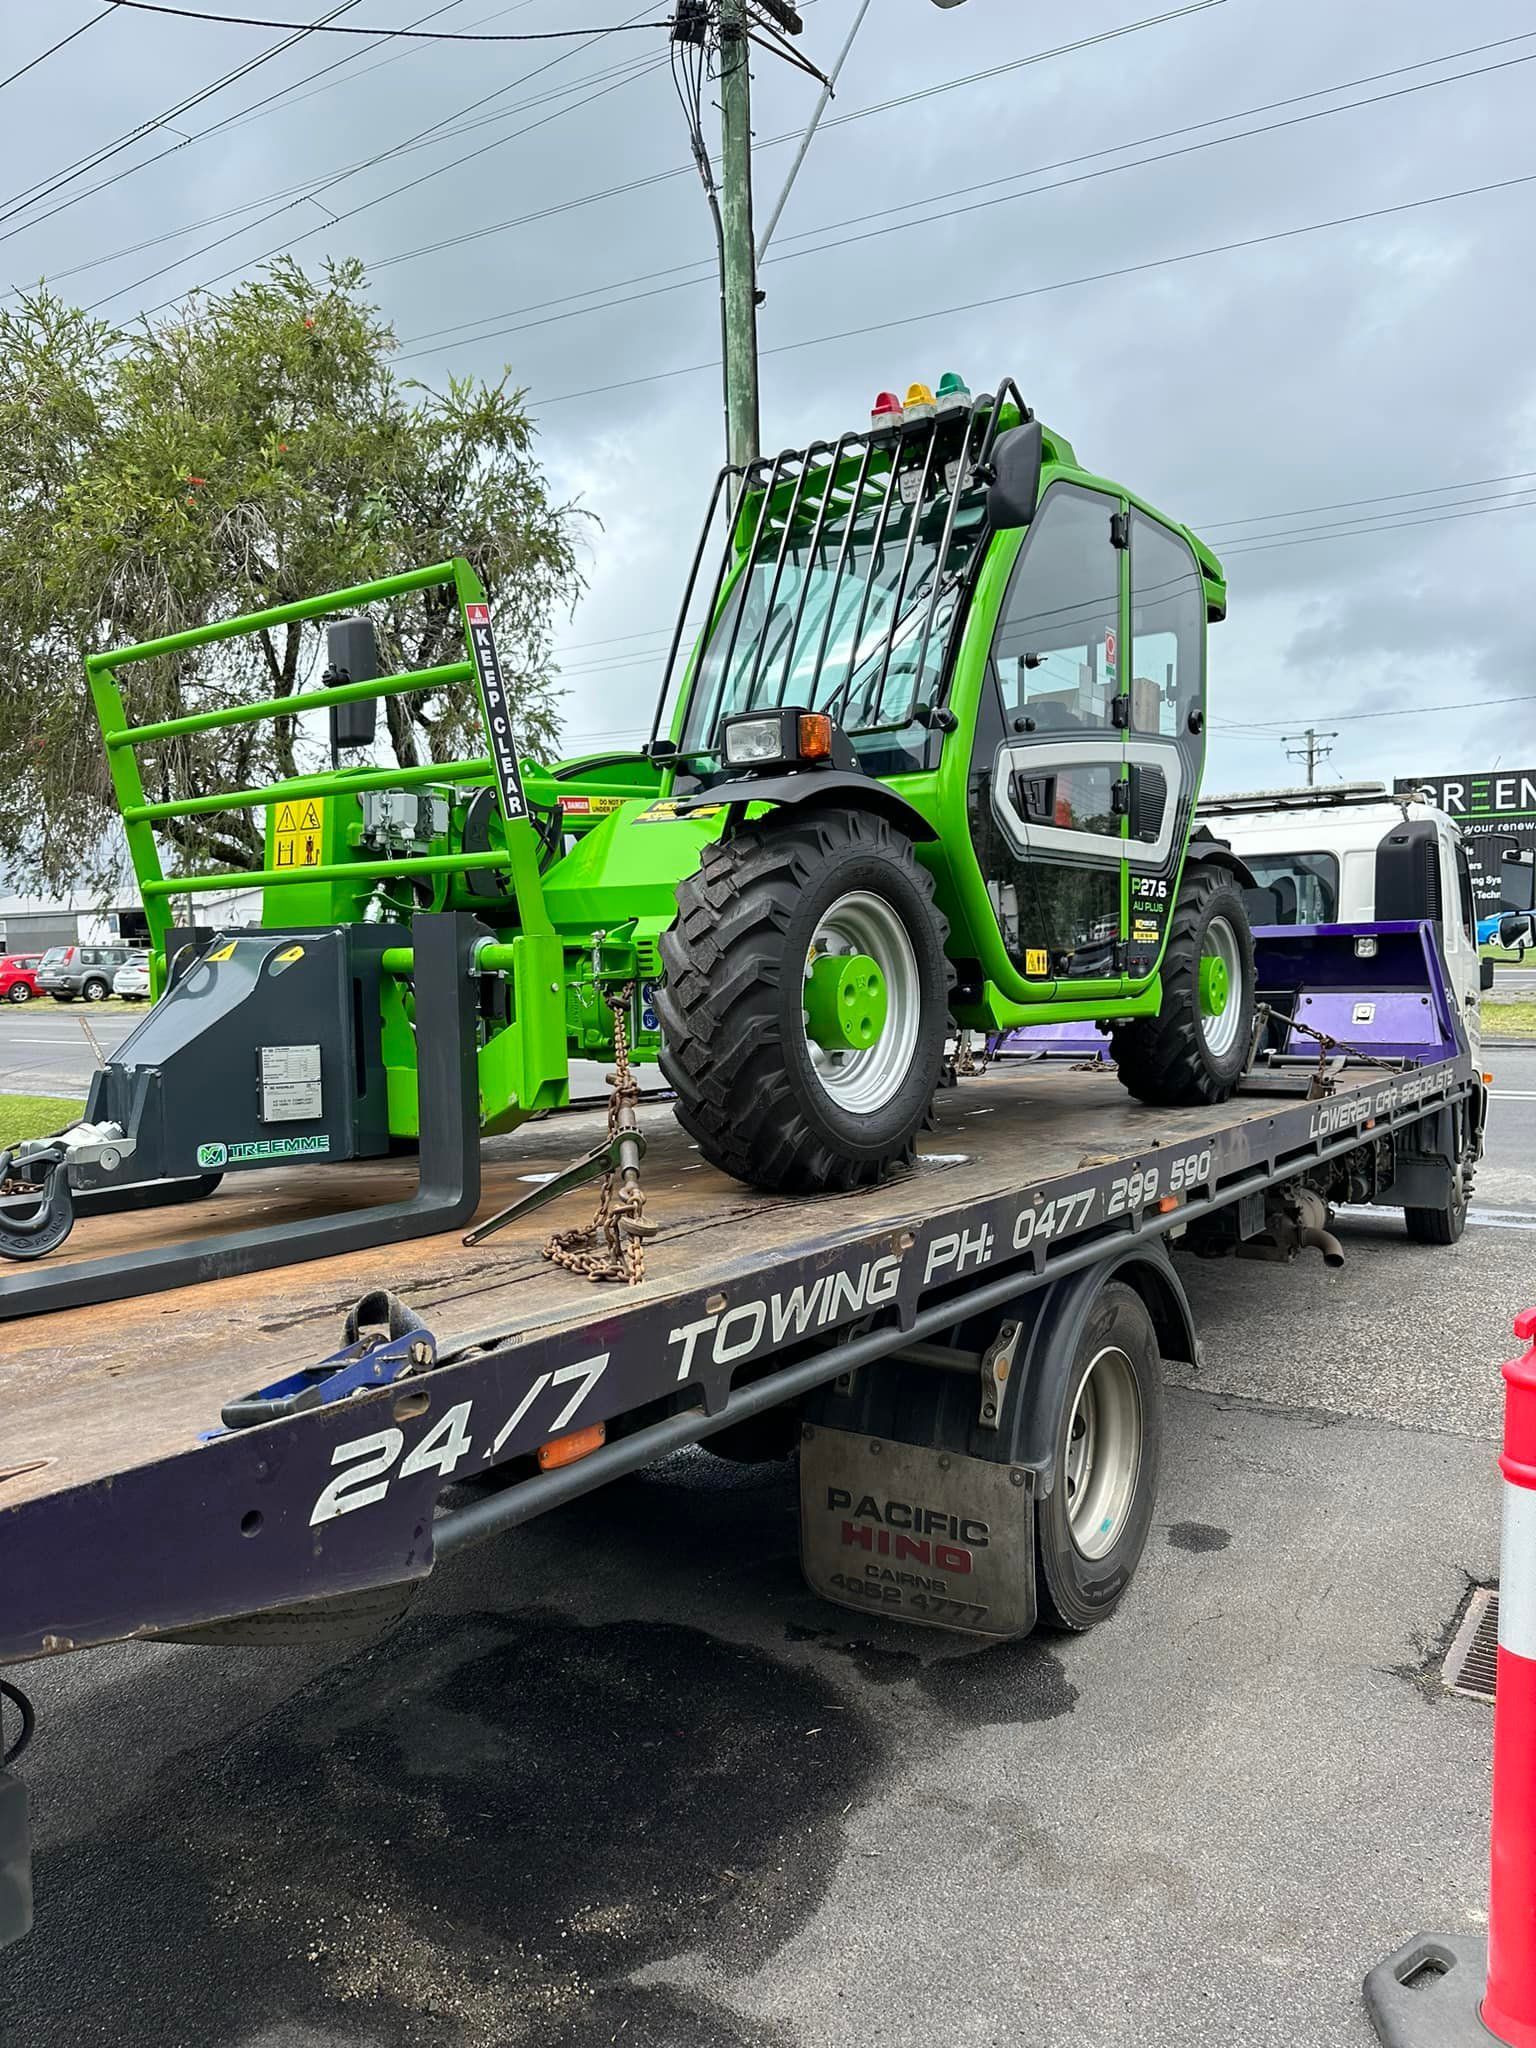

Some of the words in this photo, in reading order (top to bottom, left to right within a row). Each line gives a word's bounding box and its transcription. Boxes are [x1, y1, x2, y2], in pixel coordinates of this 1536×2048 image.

[475, 629, 500, 708] KEEP
[493, 717, 522, 814] CLEAR
[1498, 822, 1536, 832] renew
[1144, 901, 1164, 913] PLUS
[309, 1352, 610, 1527] 24/7
[668, 1254, 902, 1382] TOWING
[923, 1222, 994, 1285] PH:
[1012, 1188, 1096, 1250] 0477
[1108, 1167, 1160, 1216] 299
[1169, 1150, 1211, 1191] 590
[1309, 1096, 1372, 1139] LOWERED
[1375, 1087, 1398, 1113] CAR
[827, 1487, 990, 1547] PACIFIC
[841, 1520, 973, 1574] HINO
[829, 1573, 903, 1603] 4052
[910, 1593, 991, 1622] 4777
[864, 1564, 949, 1594] CAIRNS
